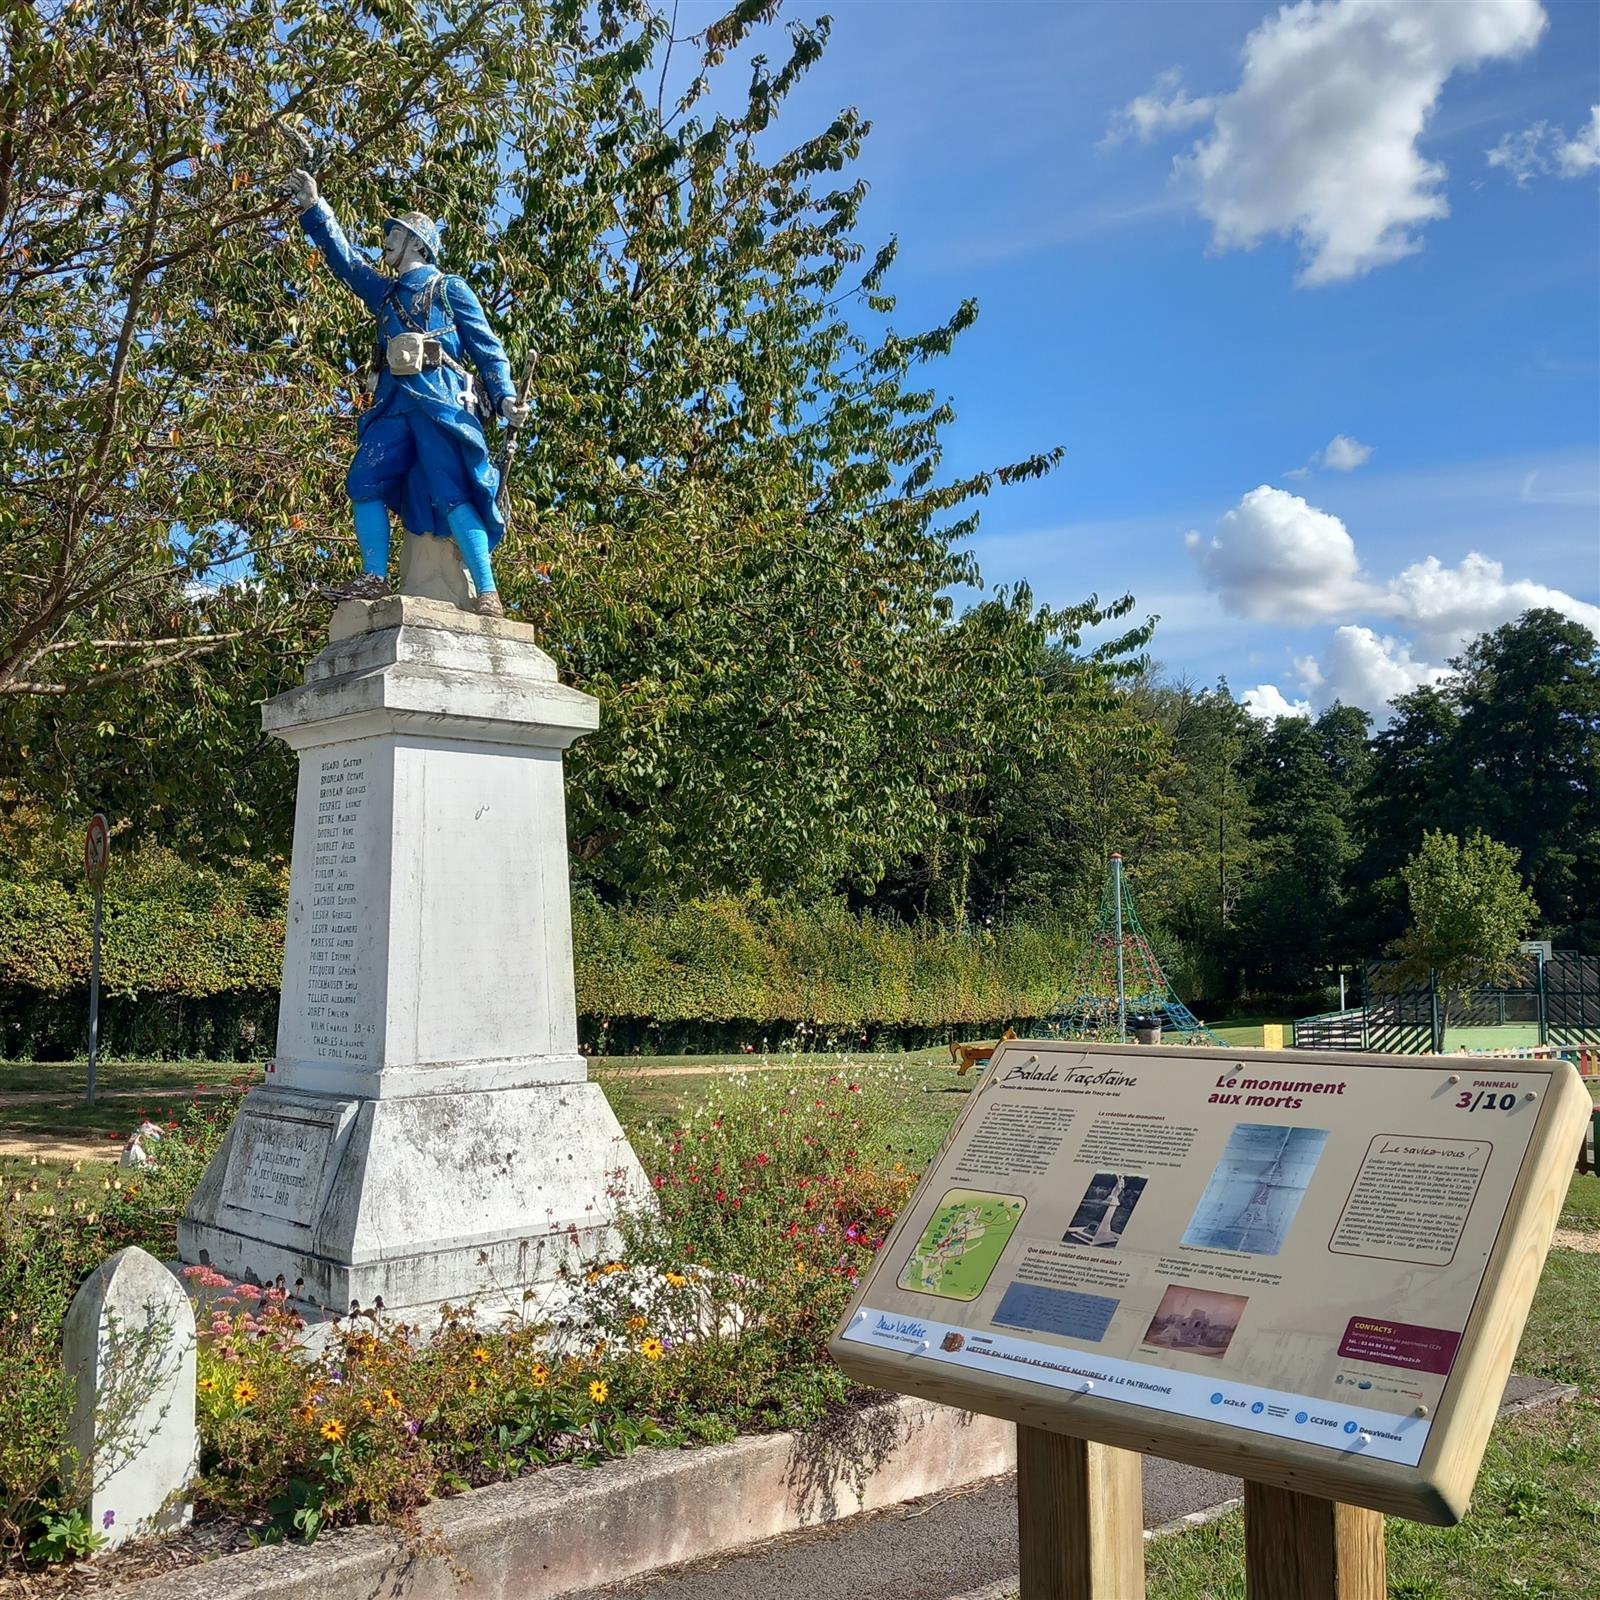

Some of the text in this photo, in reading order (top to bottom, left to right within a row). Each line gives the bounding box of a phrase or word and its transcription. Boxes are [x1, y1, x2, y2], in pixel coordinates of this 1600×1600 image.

[1001, 1064, 1137, 1087] Balade Traçotaine
[1216, 1075, 1346, 1094] Le monument
[1473, 1080, 1519, 1088] PANNEAU
[1208, 1092, 1303, 1109] aux morts
[1456, 1091, 1516, 1112] 3/10
[296, 1136, 308, 1152] VAL
[1380, 1141, 1480, 1160] Le saviez-vous ?
[1099, 1257, 1118, 1265] mains
[1354, 1322, 1393, 1334] CONTACTS
[1346, 1346, 1367, 1354] Courriel
[966, 1346, 991, 1356] METTRE
[992, 1350, 1001, 1358] EN
[1002, 1352, 1028, 1364] VALEUR
[1028, 1358, 1040, 1366] LES
[1042, 1361, 1072, 1372] ESPACES
[1072, 1367, 1106, 1380] NATURELS
[1126, 1379, 1172, 1394] PATRIMOINE
[1224, 1398, 1248, 1408] cc2v.fr
[1310, 1416, 1338, 1428] CC2V60
